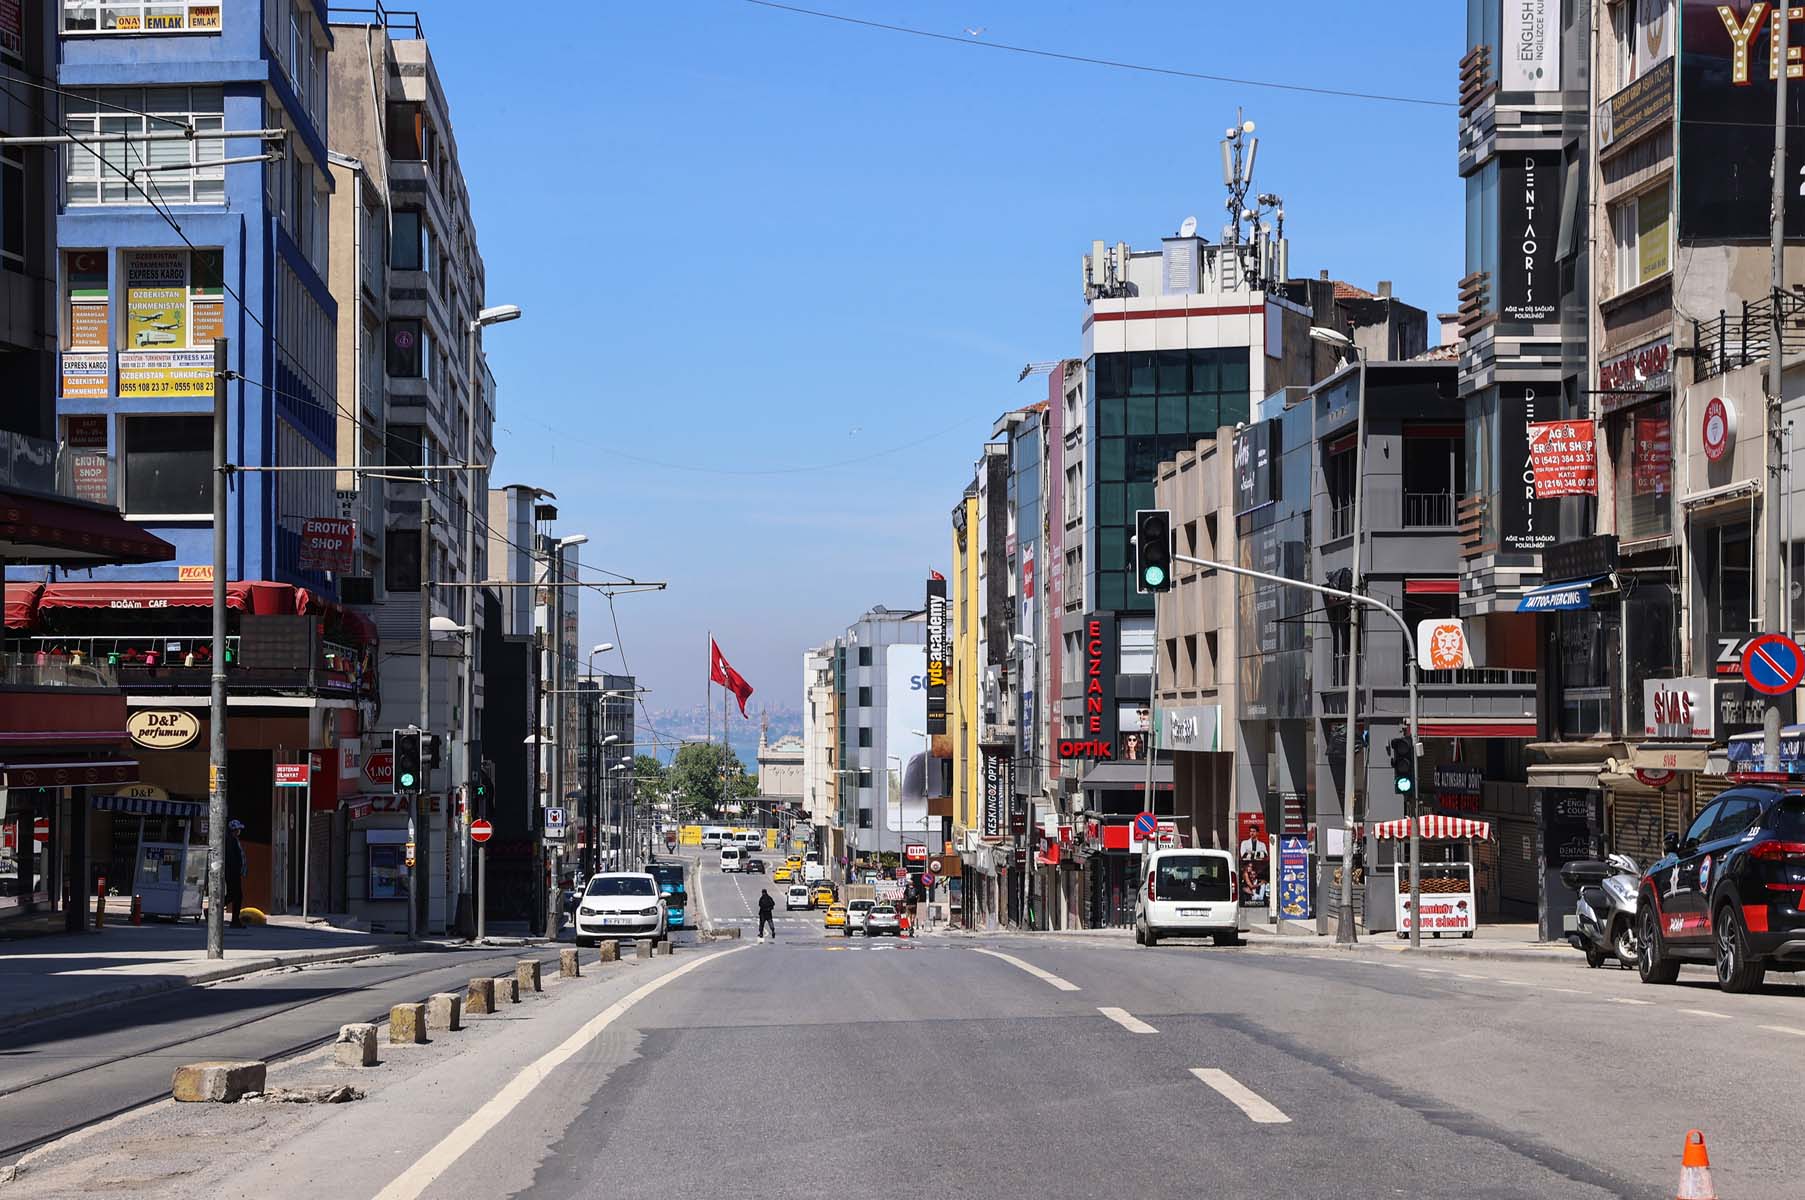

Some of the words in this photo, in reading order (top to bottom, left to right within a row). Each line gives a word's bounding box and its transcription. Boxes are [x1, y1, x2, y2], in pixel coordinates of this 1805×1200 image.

[194, 7, 214, 16] ONAY
[147, 17, 181, 29] EMLAK
[192, 17, 217, 26] EMLAK
[1521, 3, 1534, 61] ENGLISH
[1522, 157, 1537, 302] DENTAORIS
[129, 269, 159, 280] EXPRESS
[160, 269, 184, 280] KARGO
[64, 361, 87, 369] EXPRESS
[88, 361, 107, 369] KARGO
[121, 383, 137, 392] 0555
[138, 383, 150, 392] 108
[152, 383, 160, 391] 23
[162, 383, 169, 391] 37
[175, 383, 191, 391] 0555
[193, 383, 204, 391] 108
[206, 383, 213, 391] 23
[1569, 441, 1593, 452] SHOP
[1541, 456, 1560, 465] (542)
[1561, 455, 1574, 463] 384
[1575, 454, 1585, 462] 33
[1586, 454, 1594, 462] 37
[79, 469, 102, 477] SHOP
[1564, 479, 1576, 487] 348
[307, 521, 349, 535] EROTİK
[312, 537, 343, 550] SHOP
[180, 567, 214, 578] PEGAS
[148, 599, 168, 608] CAFE
[1087, 620, 1103, 734] ECZANE
[1654, 683, 1690, 725] SİVAS
[148, 714, 179, 727] D&P
[138, 727, 189, 738] perfumum
[1059, 739, 1112, 758] OPTİK
[370, 766, 394, 777] 1.NO
[131, 788, 154, 798] D&P
[1403, 917, 1434, 928] OUN
[1435, 915, 1469, 928] SİMİTİ
